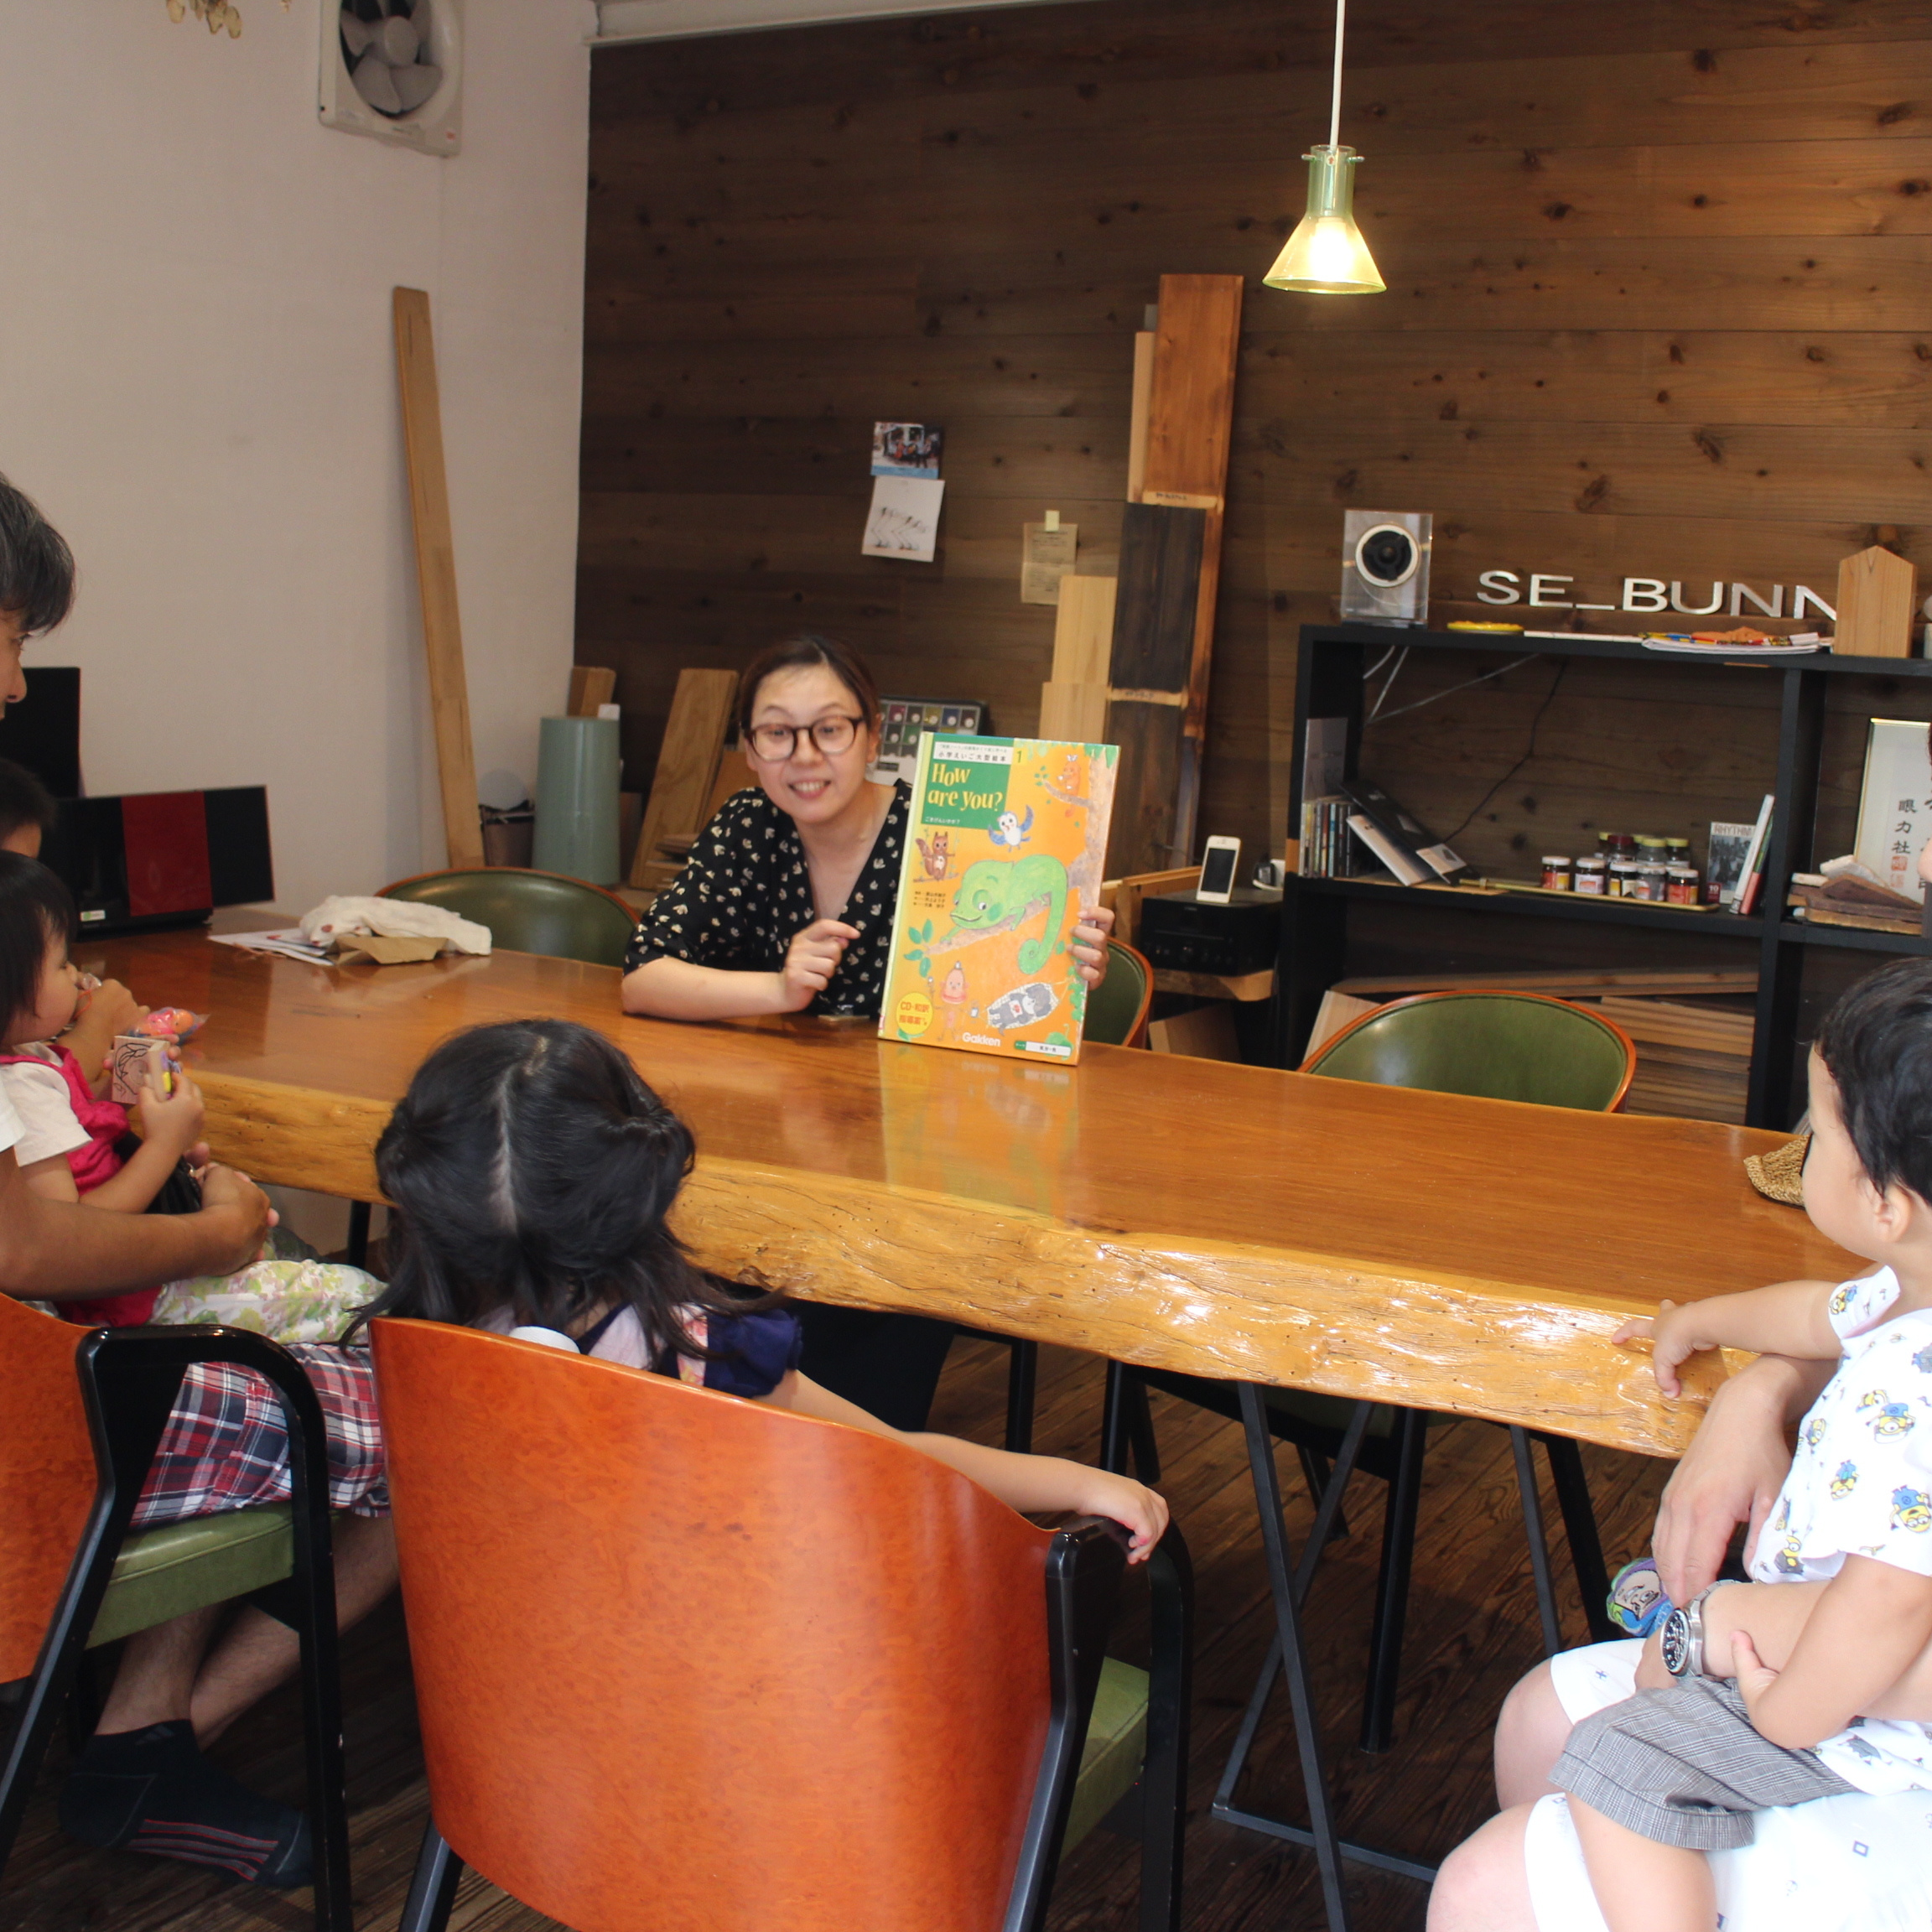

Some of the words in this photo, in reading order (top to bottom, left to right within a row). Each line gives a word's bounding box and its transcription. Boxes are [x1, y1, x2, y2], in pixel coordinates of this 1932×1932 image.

[1016, 750, 1023, 763] 1
[932, 763, 971, 787] How
[927, 790, 959, 807] are
[959, 791, 1004, 812] you?
[963, 1032, 1001, 1046] Gakken
